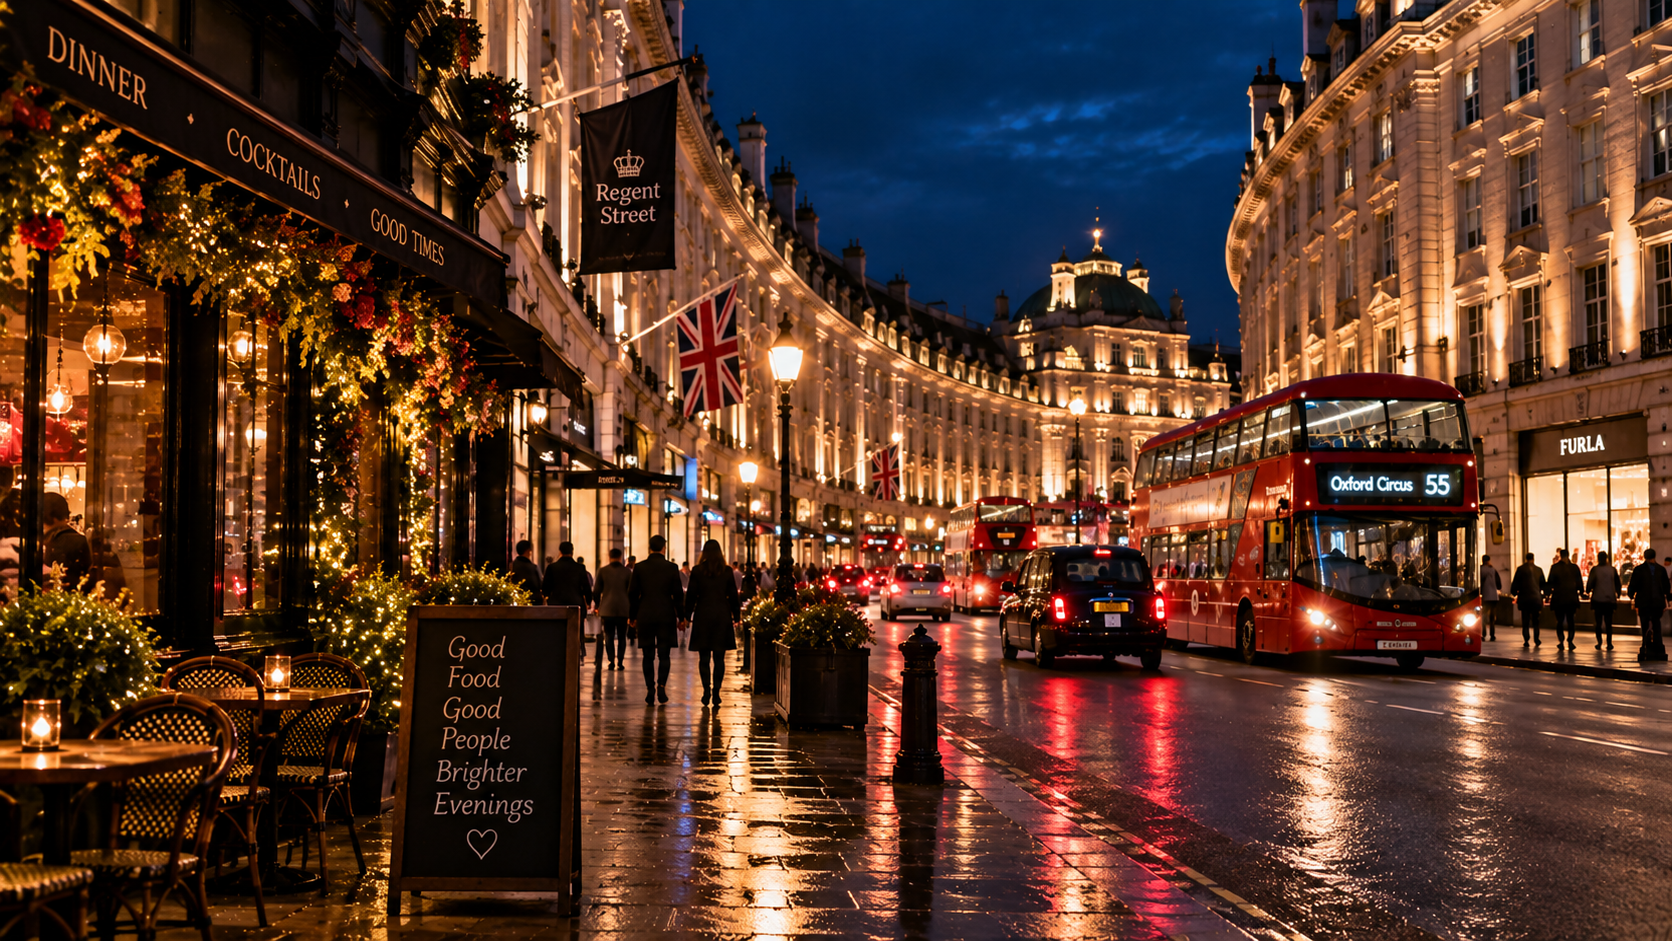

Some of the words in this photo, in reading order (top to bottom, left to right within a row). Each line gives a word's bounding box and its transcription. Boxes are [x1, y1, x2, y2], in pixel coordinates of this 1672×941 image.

[47, 25, 149, 110] DINNER
[226, 127, 322, 200] COCKTAILS
[595, 182, 661, 206] Regent
[600, 205, 657, 225] Street
[370, 207, 408, 246] GOOD
[411, 229, 446, 267] TIMES
[1559, 434, 1606, 456] FURLA
[1330, 475, 1374, 492] Oxford
[1376, 475, 1414, 492] Circus
[1424, 473, 1451, 496] 55
[448, 635, 506, 662] Good
[447, 665, 502, 688] Food
[443, 696, 503, 724] Good
[441, 726, 511, 757] People
[436, 758, 528, 791] Brighter
[433, 791, 534, 824] Evenings
